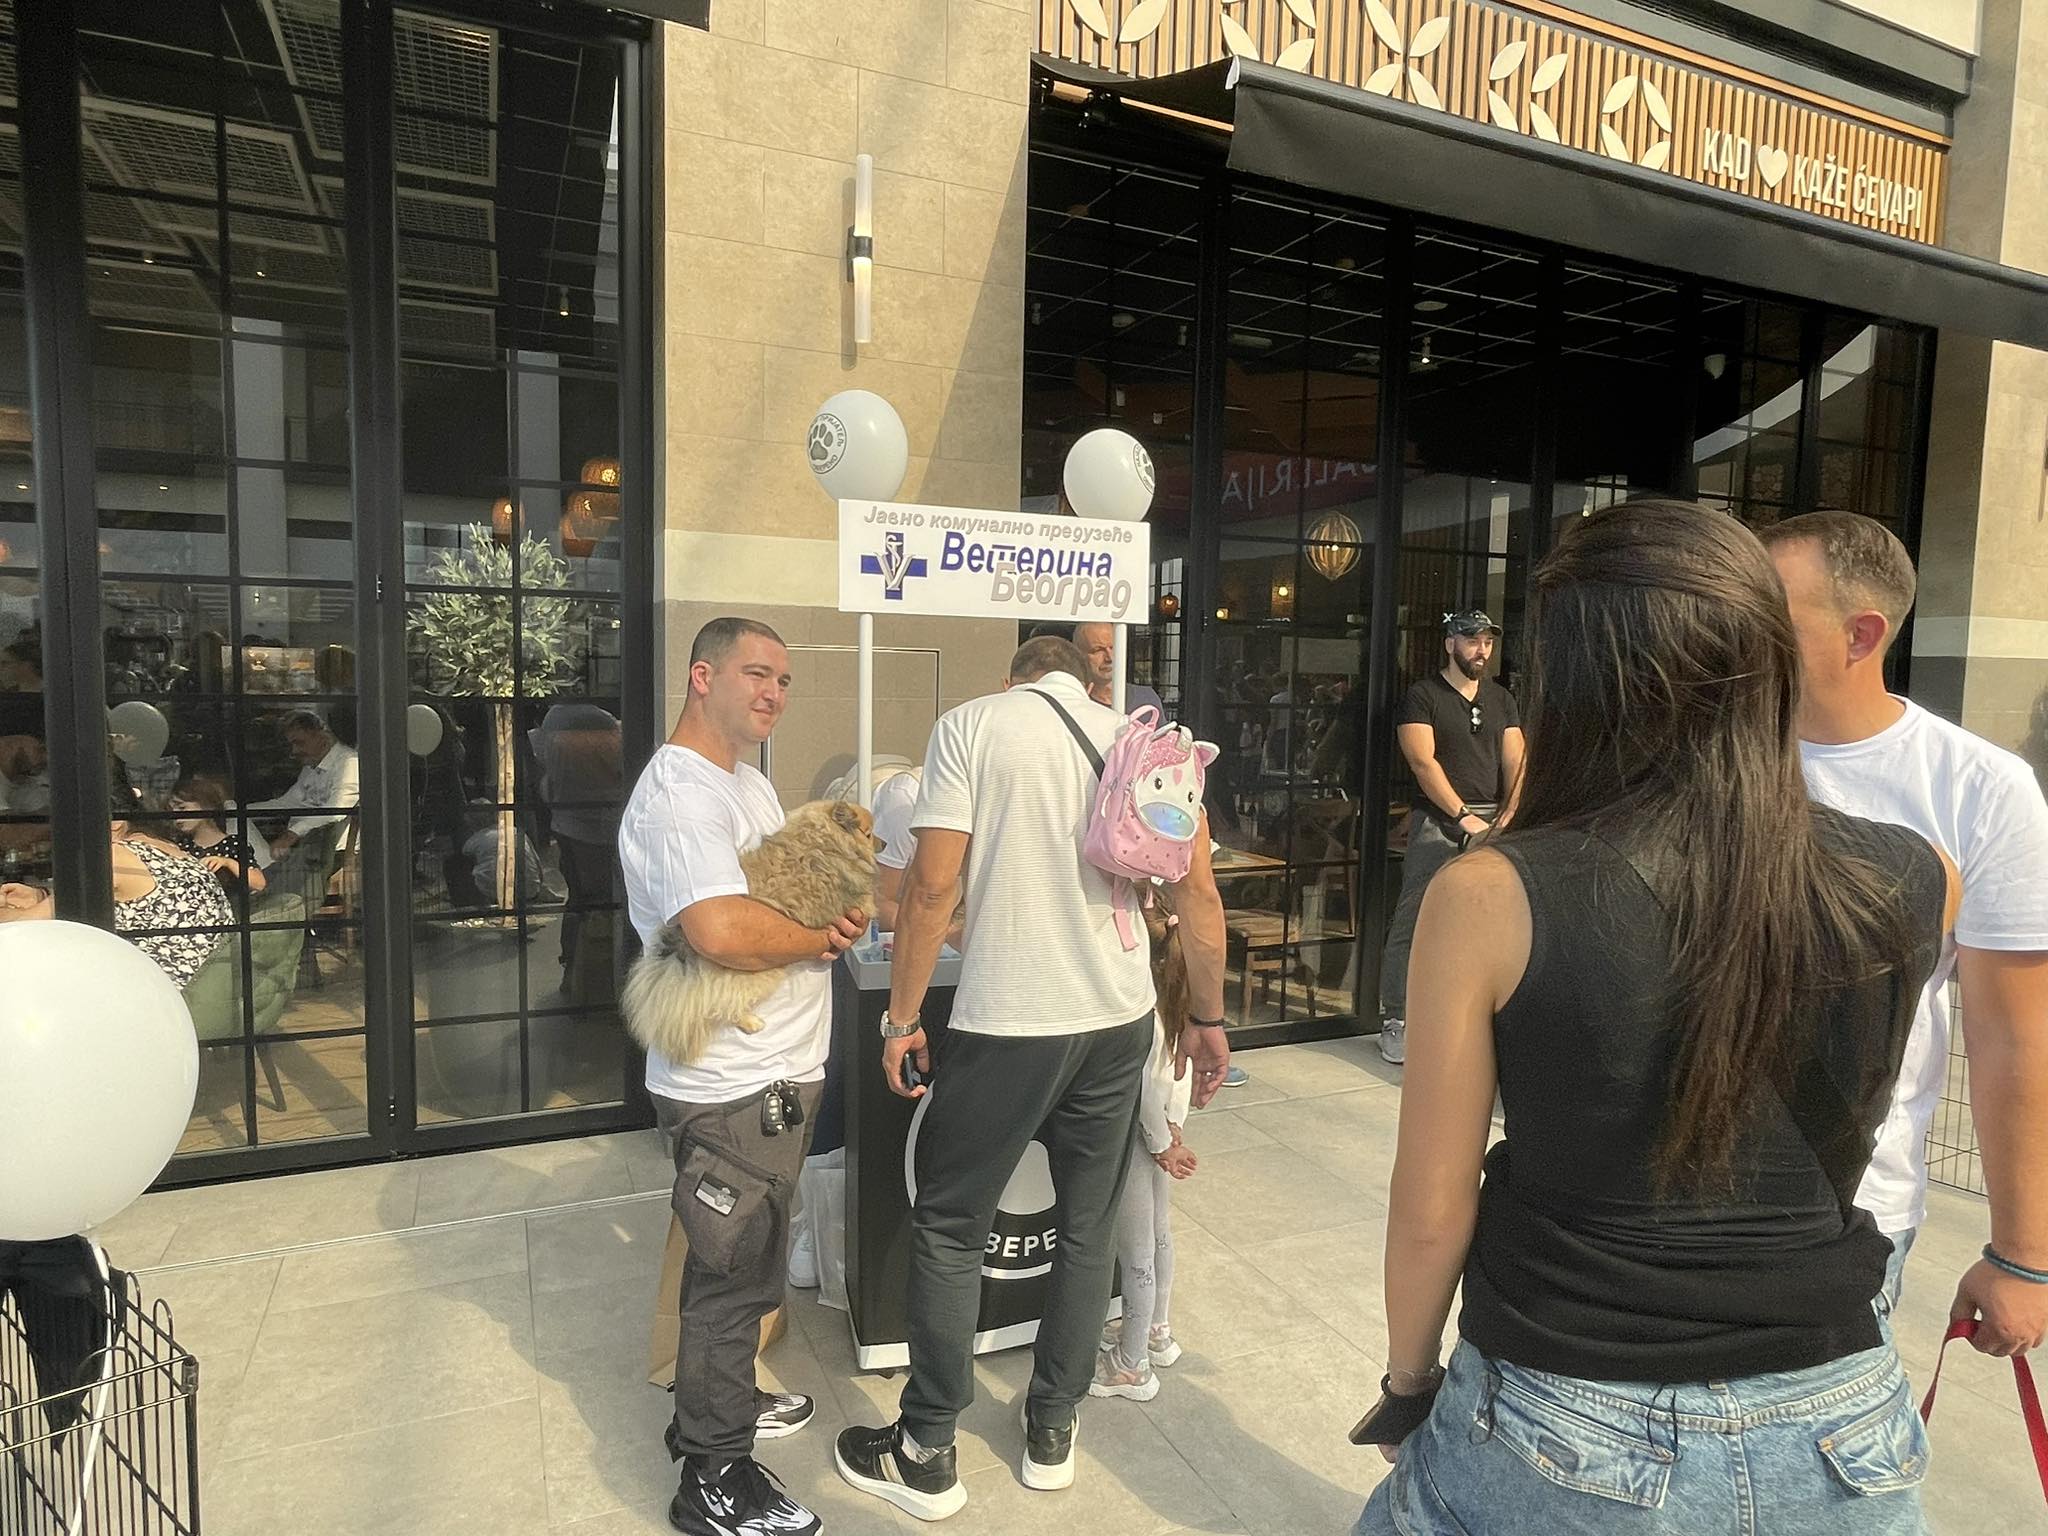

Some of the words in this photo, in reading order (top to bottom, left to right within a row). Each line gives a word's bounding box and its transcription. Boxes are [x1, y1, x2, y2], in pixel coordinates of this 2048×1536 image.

[1703, 127, 1750, 181] KAD
[1793, 153, 1849, 209] KAŽE
[1852, 164, 1923, 229] ĆEVAPI
[863, 505, 925, 527] Јавно
[930, 515, 1034, 535] комунално
[1038, 523, 1133, 544] предузеће
[941, 531, 1113, 581] Ветерина
[990, 562, 1132, 619] Београд
